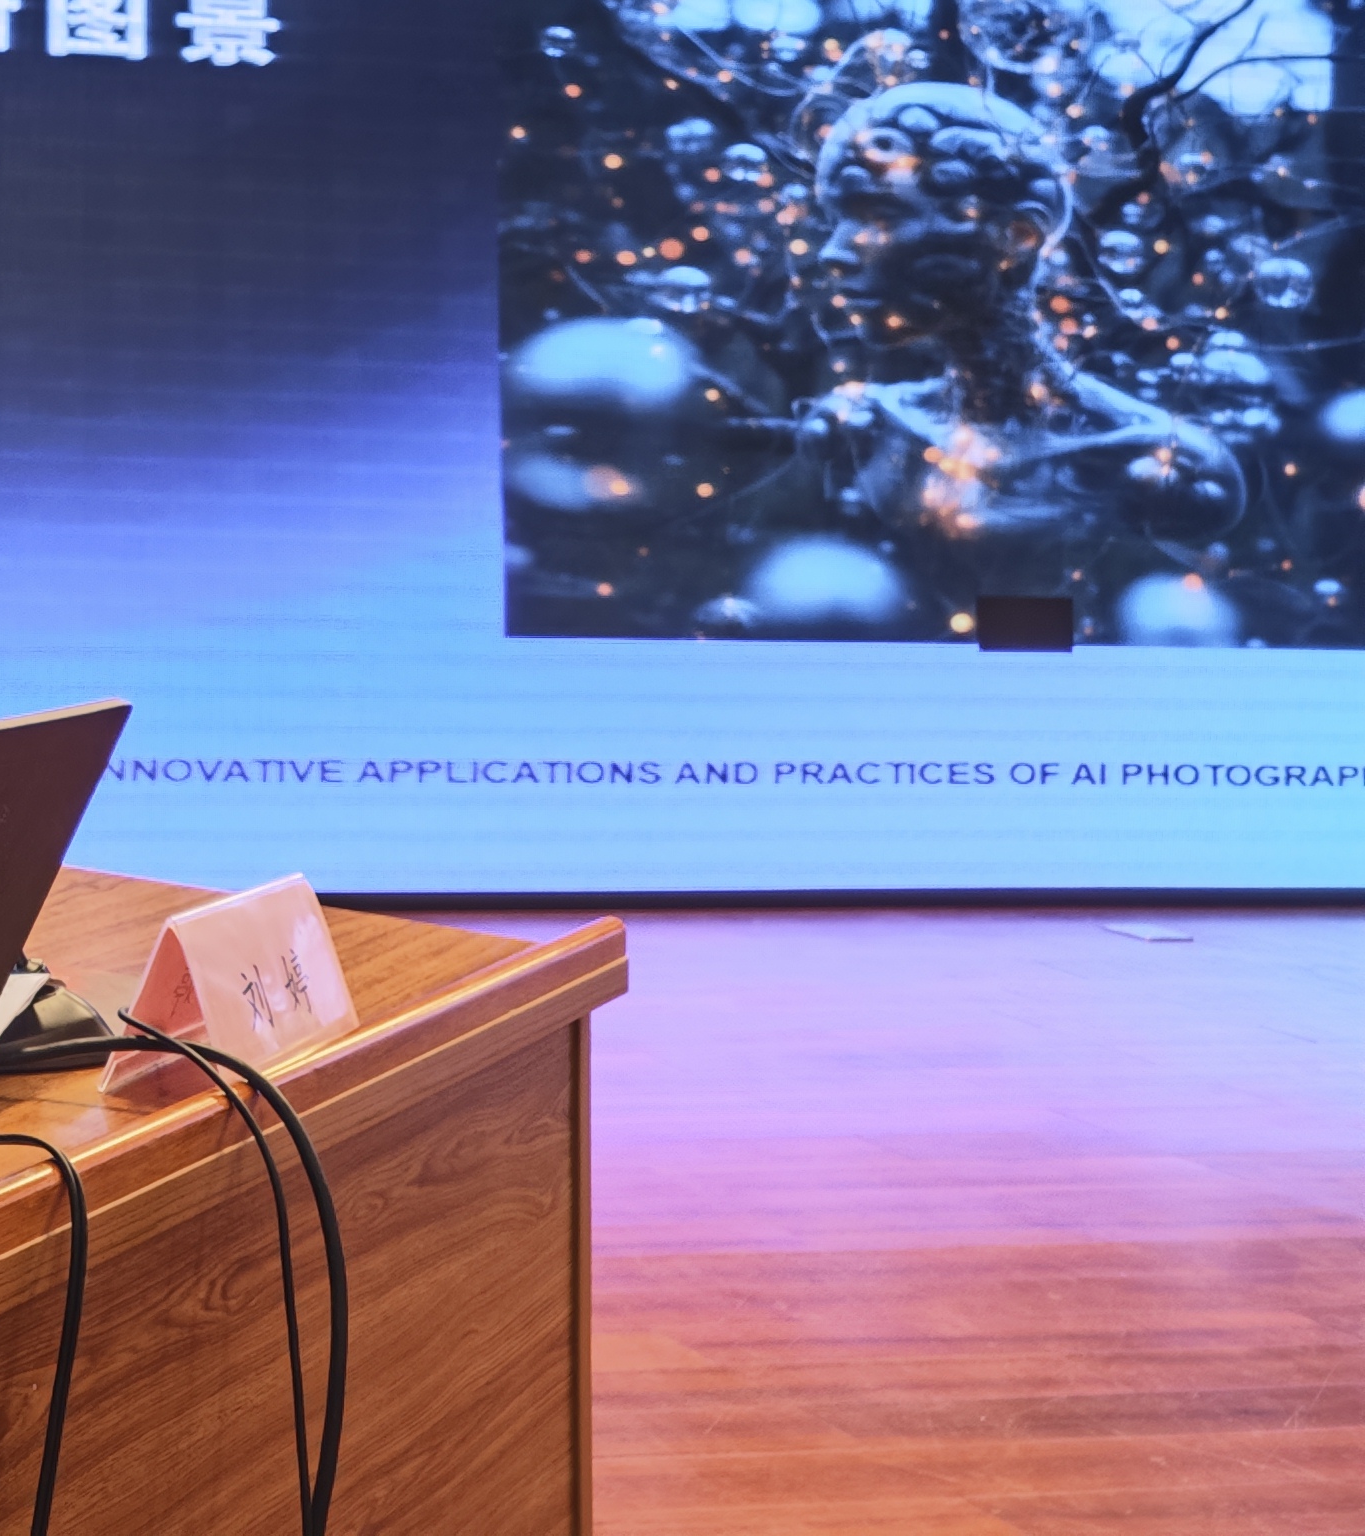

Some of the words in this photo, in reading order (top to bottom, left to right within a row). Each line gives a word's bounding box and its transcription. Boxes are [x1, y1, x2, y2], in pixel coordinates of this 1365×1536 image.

[357, 757, 662, 788] APPLICATIONS
[674, 760, 759, 787] AND
[773, 760, 996, 787] PRACTICES
[1009, 760, 1060, 787] OF
[1070, 762, 1107, 787] AI
[241, 948, 313, 1034] 刘婷
